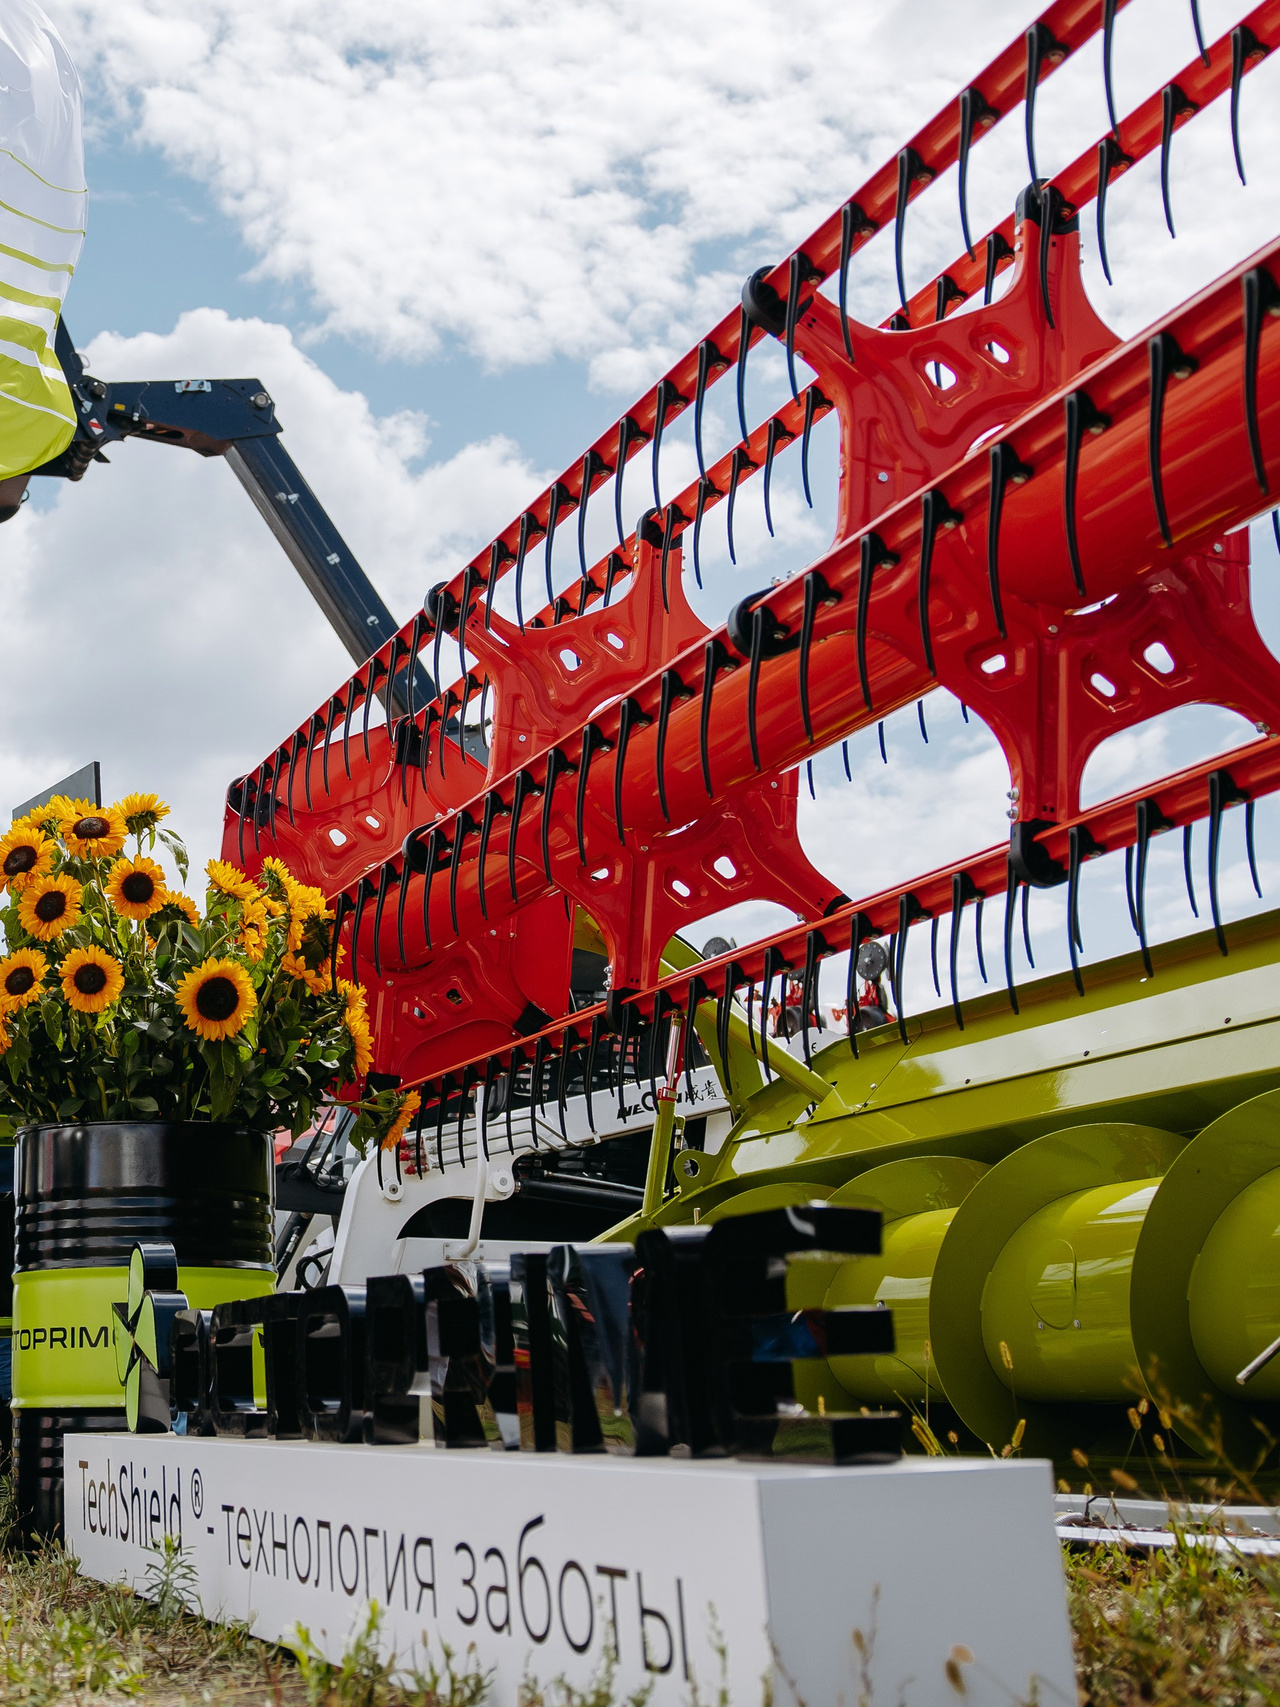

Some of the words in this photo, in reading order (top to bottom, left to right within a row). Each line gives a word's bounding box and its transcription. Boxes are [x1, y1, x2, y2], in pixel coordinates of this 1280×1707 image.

[326, 552, 340, 565] B
[366, 615, 379, 626] C
[12, 1325, 115, 1352] TOPRIM
[221, 1504, 439, 1618] технология
[455, 1514, 690, 1681] заботы
